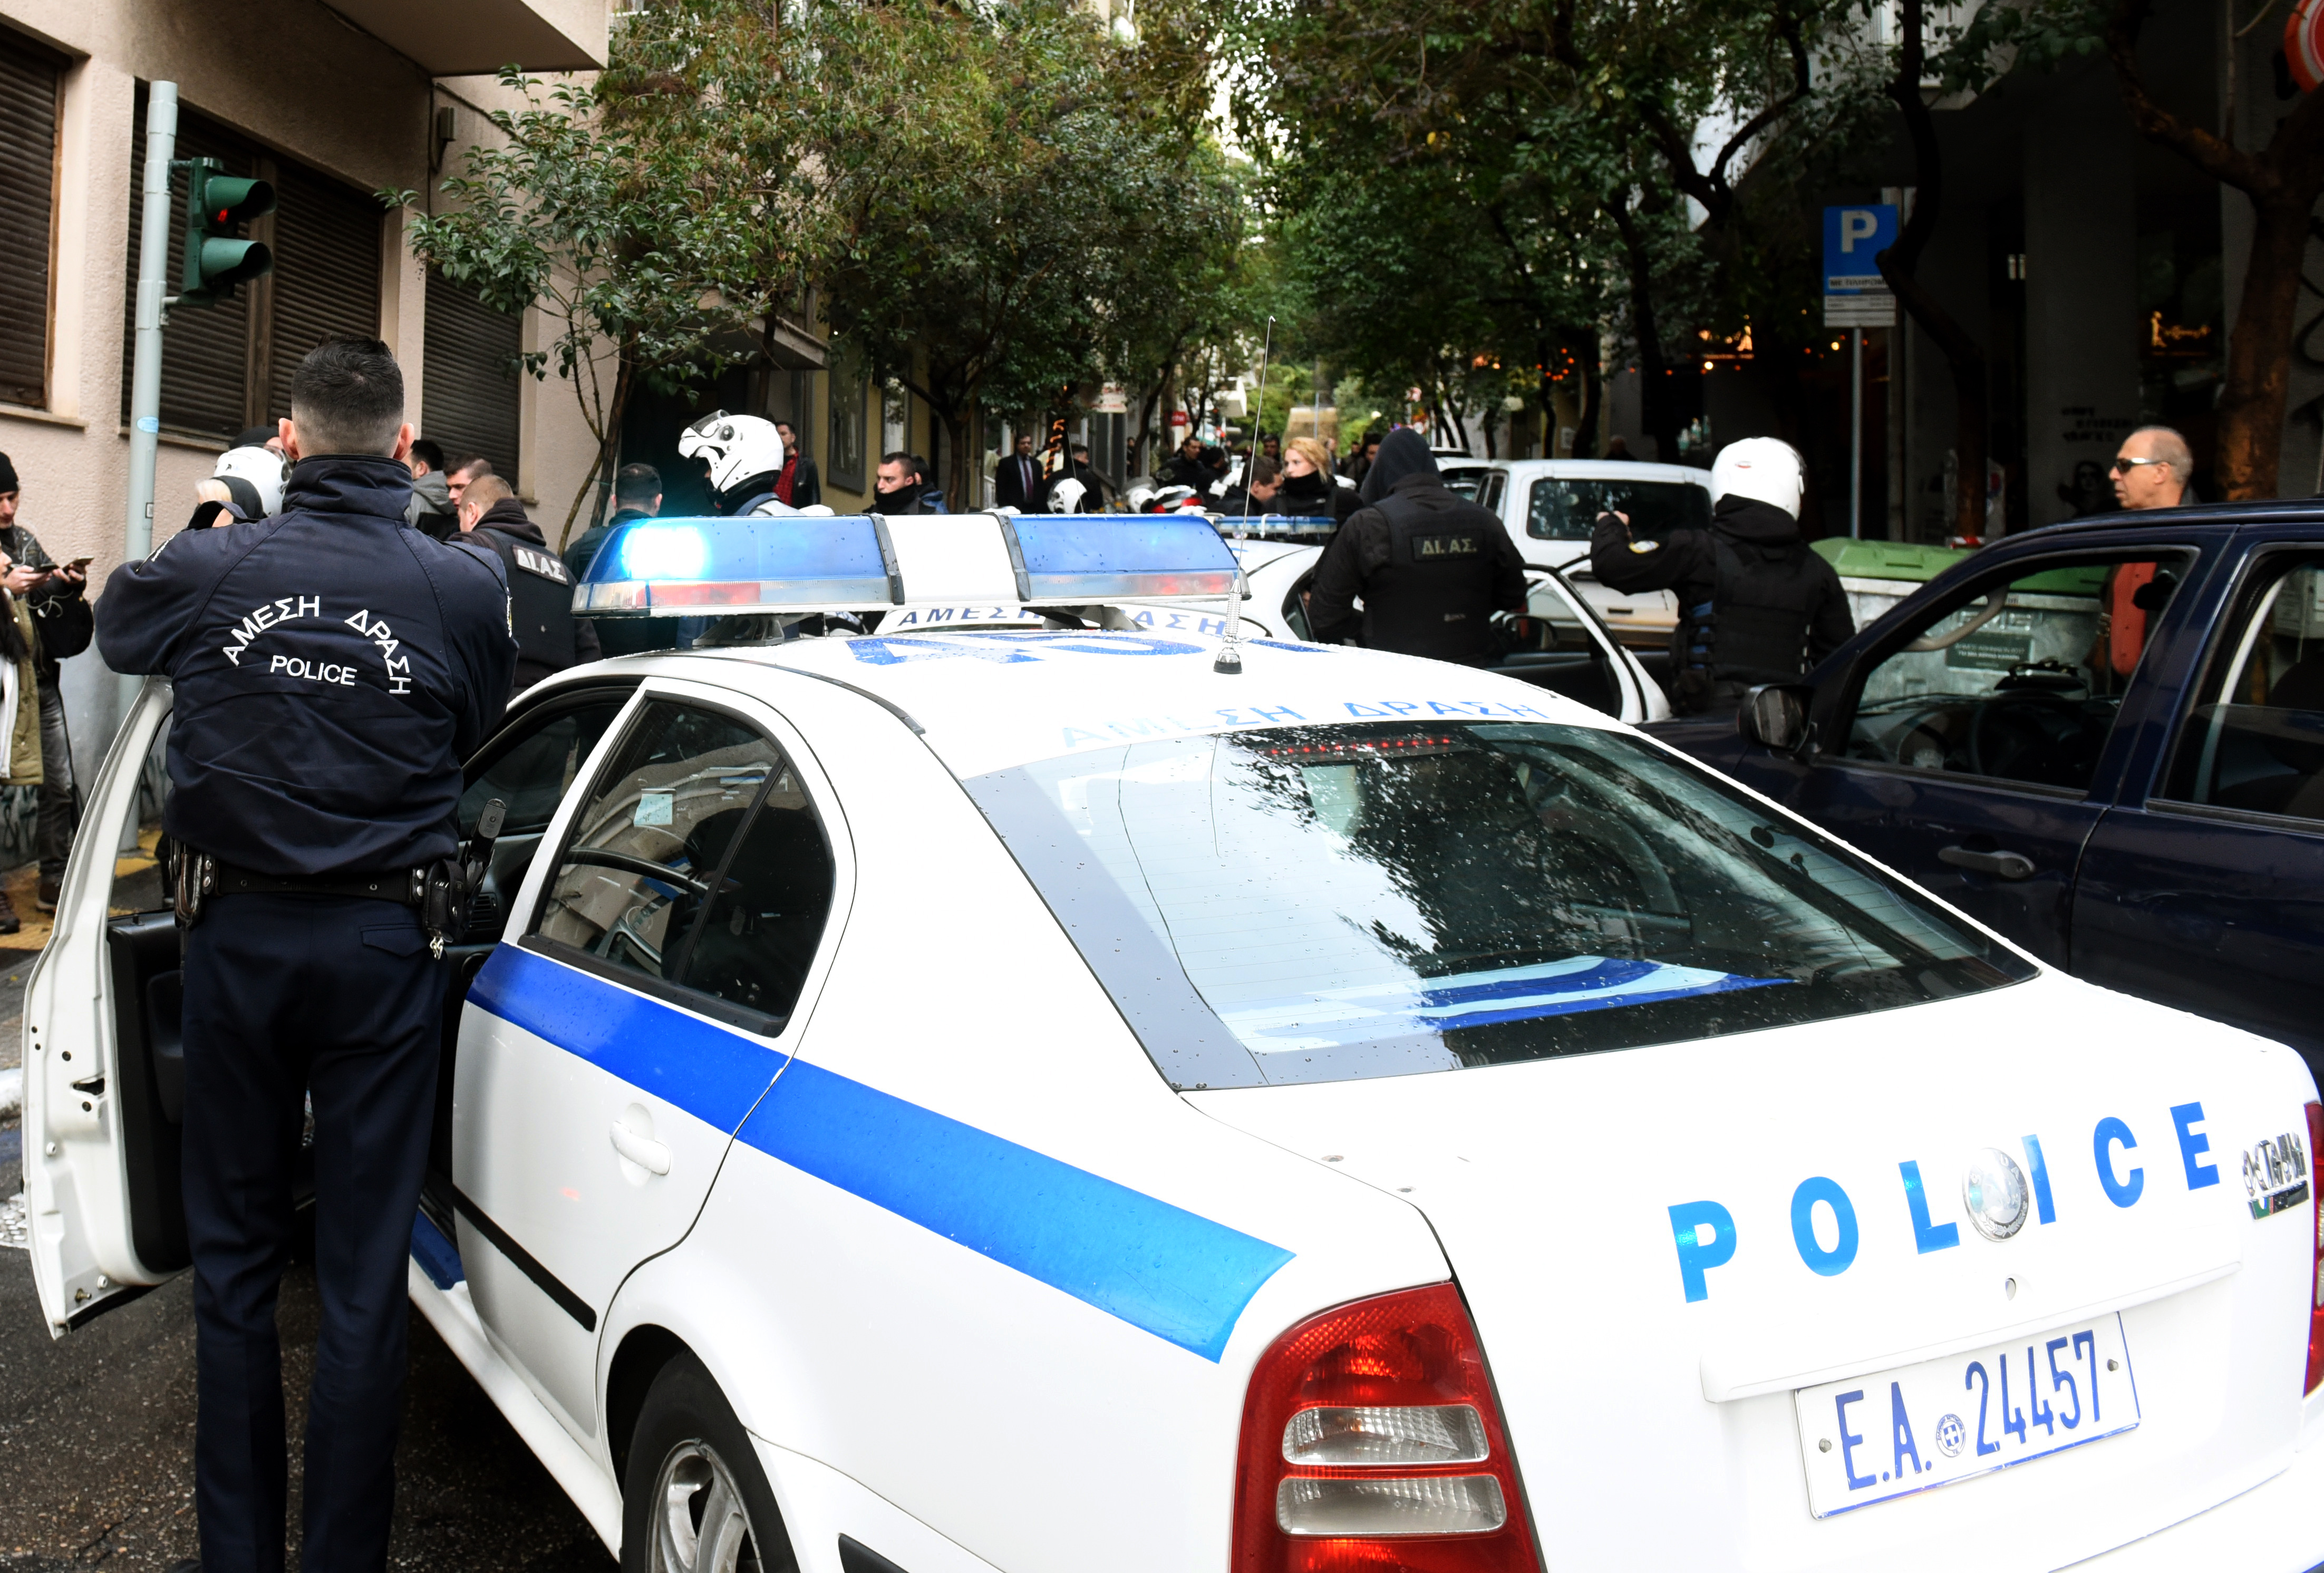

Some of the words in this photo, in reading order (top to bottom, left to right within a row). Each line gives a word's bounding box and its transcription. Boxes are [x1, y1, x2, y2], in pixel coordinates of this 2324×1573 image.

[1842, 209, 1878, 253] P
[223, 596, 319, 667] ΑΜΕΣΗ
[344, 609, 412, 694] ΔΡΑΣΗ
[270, 655, 357, 686] POLICE
[1343, 701, 1550, 719] ΔΡΑΣΗ
[1668, 1101, 2220, 1303] POLICE
[1965, 1329, 2100, 1457] 24457
